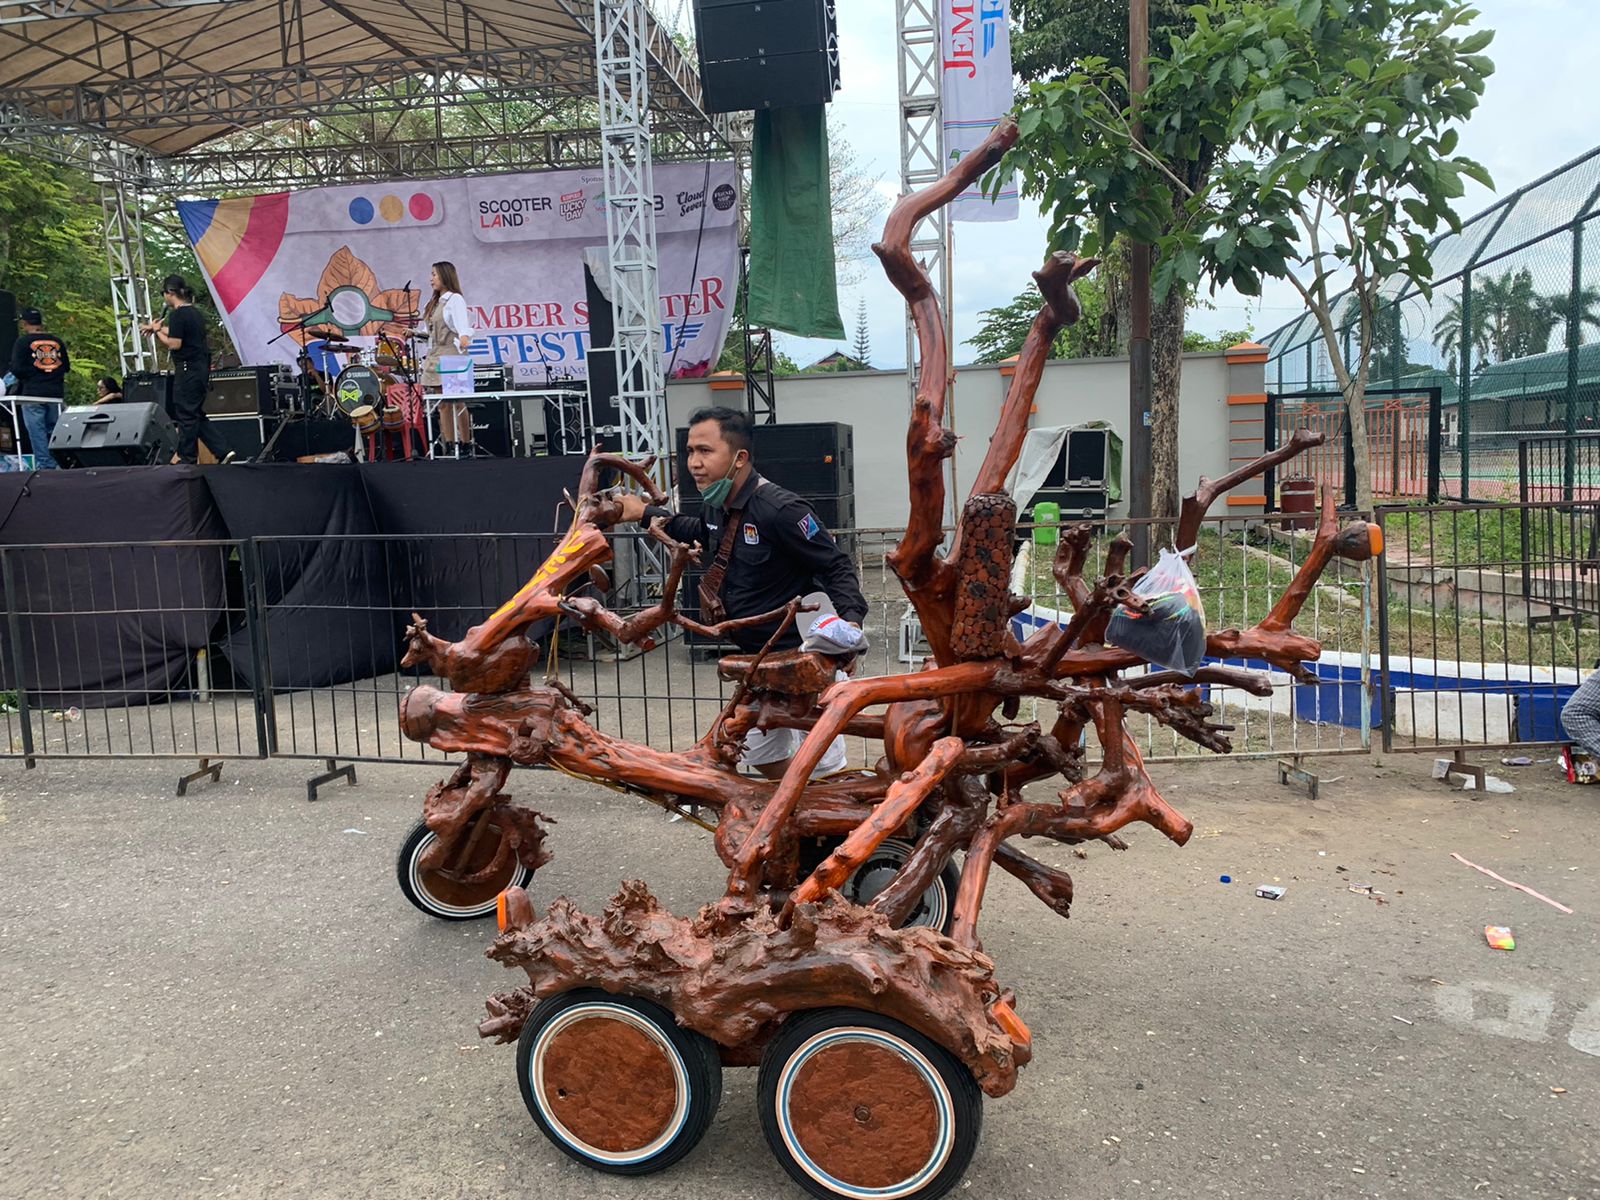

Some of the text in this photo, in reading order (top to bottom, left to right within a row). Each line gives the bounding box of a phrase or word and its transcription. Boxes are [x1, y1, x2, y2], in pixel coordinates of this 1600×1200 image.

[943, 0, 976, 78] JEM
[479, 197, 553, 214] SCOOTER
[560, 198, 587, 217] LUCKY
[480, 213, 524, 229] LAND
[565, 209, 584, 222] DAY
